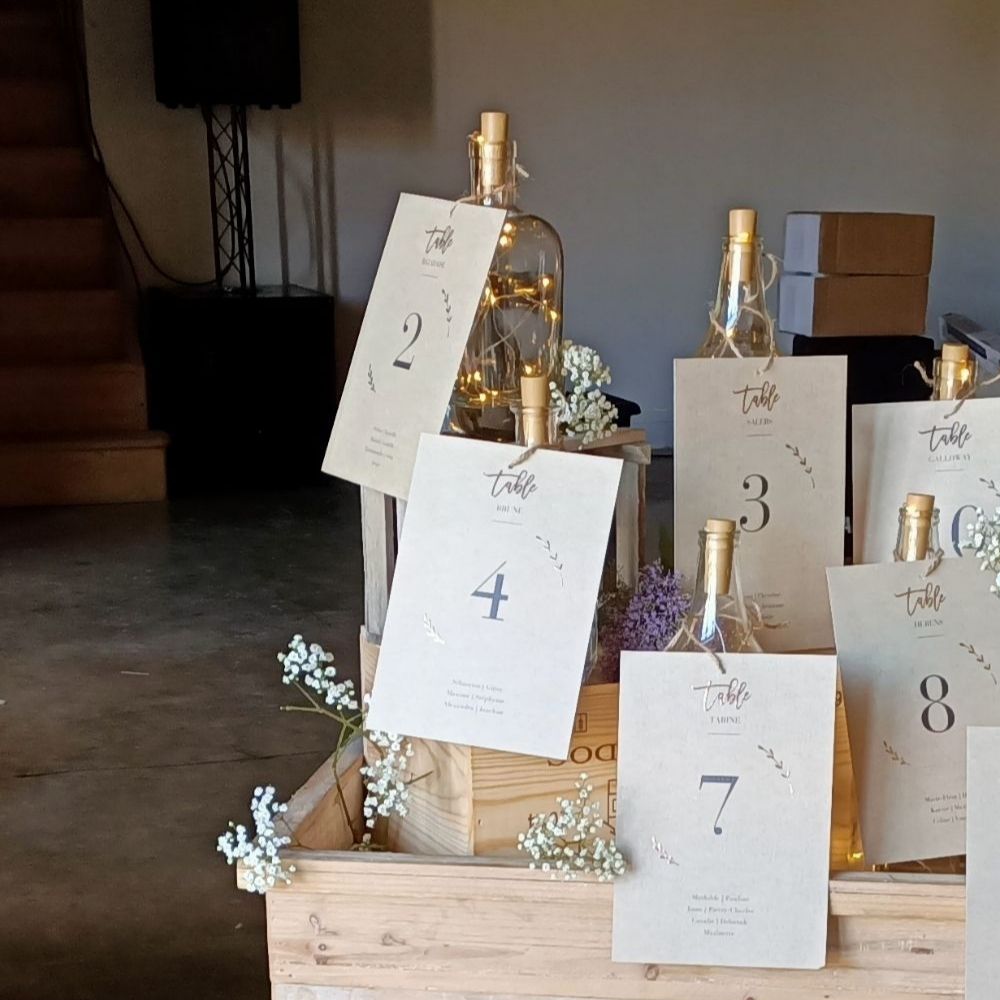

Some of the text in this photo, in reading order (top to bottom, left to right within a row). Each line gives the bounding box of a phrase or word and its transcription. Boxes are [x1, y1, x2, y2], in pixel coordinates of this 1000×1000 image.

[392, 312, 422, 370] 2
[733, 381, 780, 414] table
[918, 421, 972, 452] table
[483, 469, 538, 500] table
[739, 473, 770, 533] 3
[470, 560, 509, 622] 4
[894, 583, 946, 616] table
[691, 678, 751, 711] table
[919, 674, 956, 733] 8
[699, 775, 739, 835] 7
